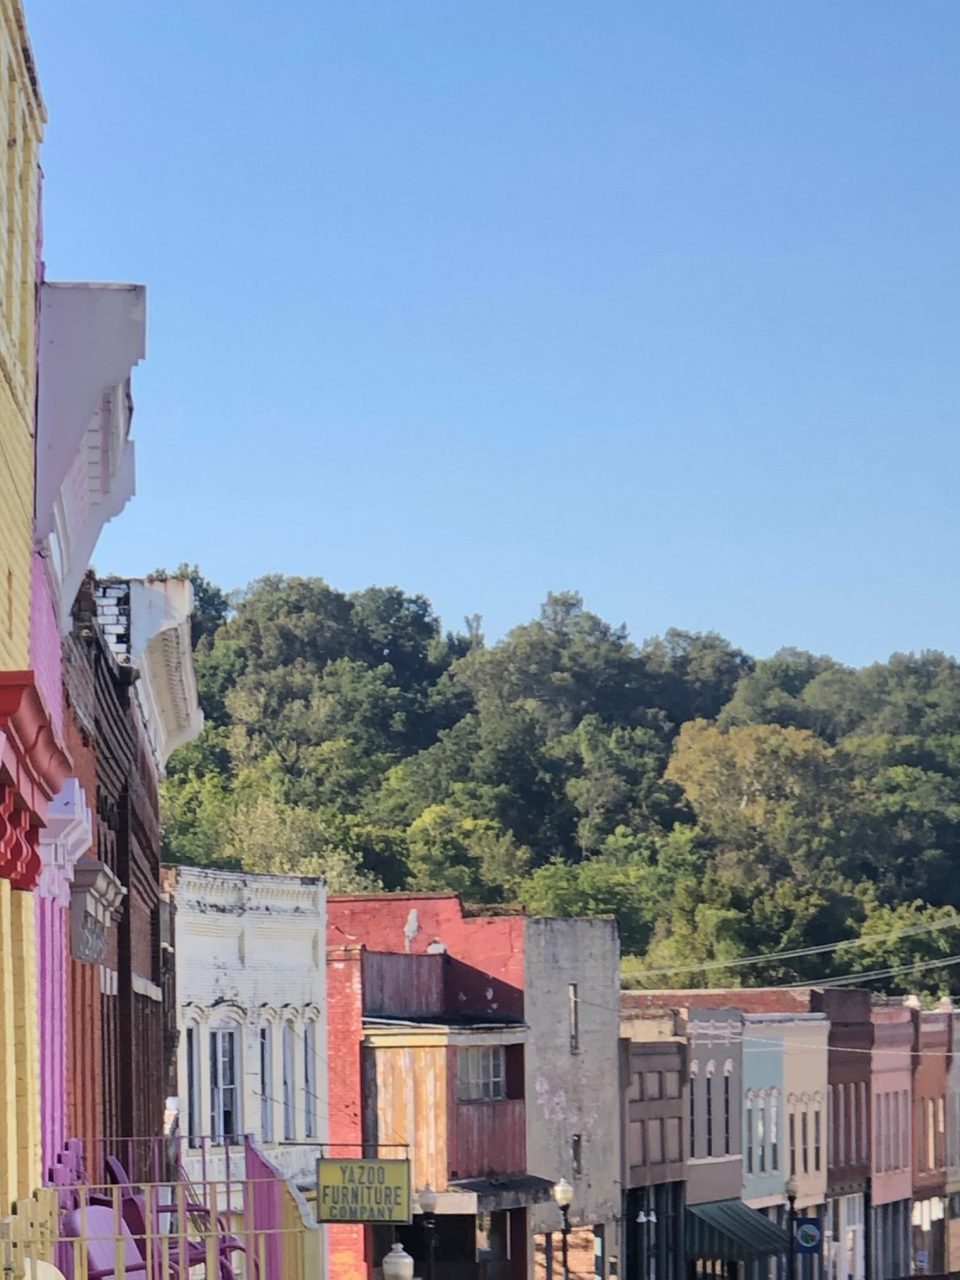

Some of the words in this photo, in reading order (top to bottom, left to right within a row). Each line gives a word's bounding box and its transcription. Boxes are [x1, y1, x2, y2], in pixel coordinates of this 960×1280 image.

[340, 1165, 385, 1184] YAZOO
[322, 1185, 402, 1206] FURNITURE
[329, 1206, 394, 1220] COMPANY
